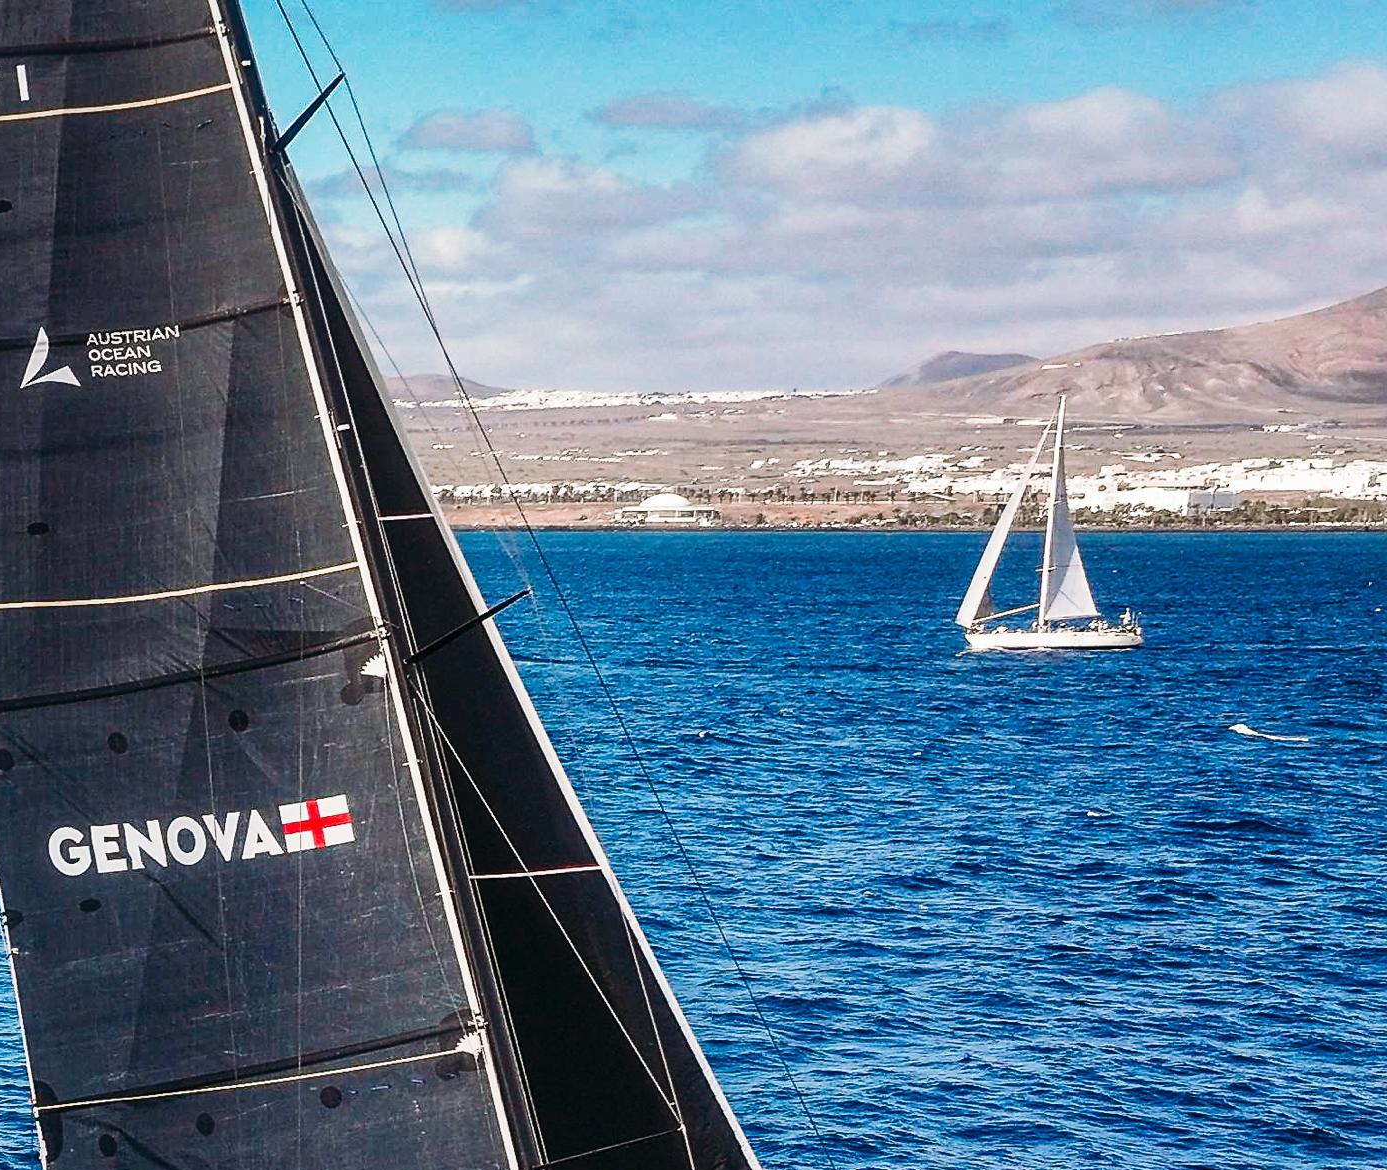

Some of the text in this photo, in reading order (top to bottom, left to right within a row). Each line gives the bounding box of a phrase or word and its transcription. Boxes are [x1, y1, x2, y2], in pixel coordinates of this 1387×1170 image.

[86, 325, 181, 346] AUSTRIAN
[88, 345, 152, 361] OCEAN
[90, 360, 163, 378] RACING
[48, 810, 284, 877] GENOVA
